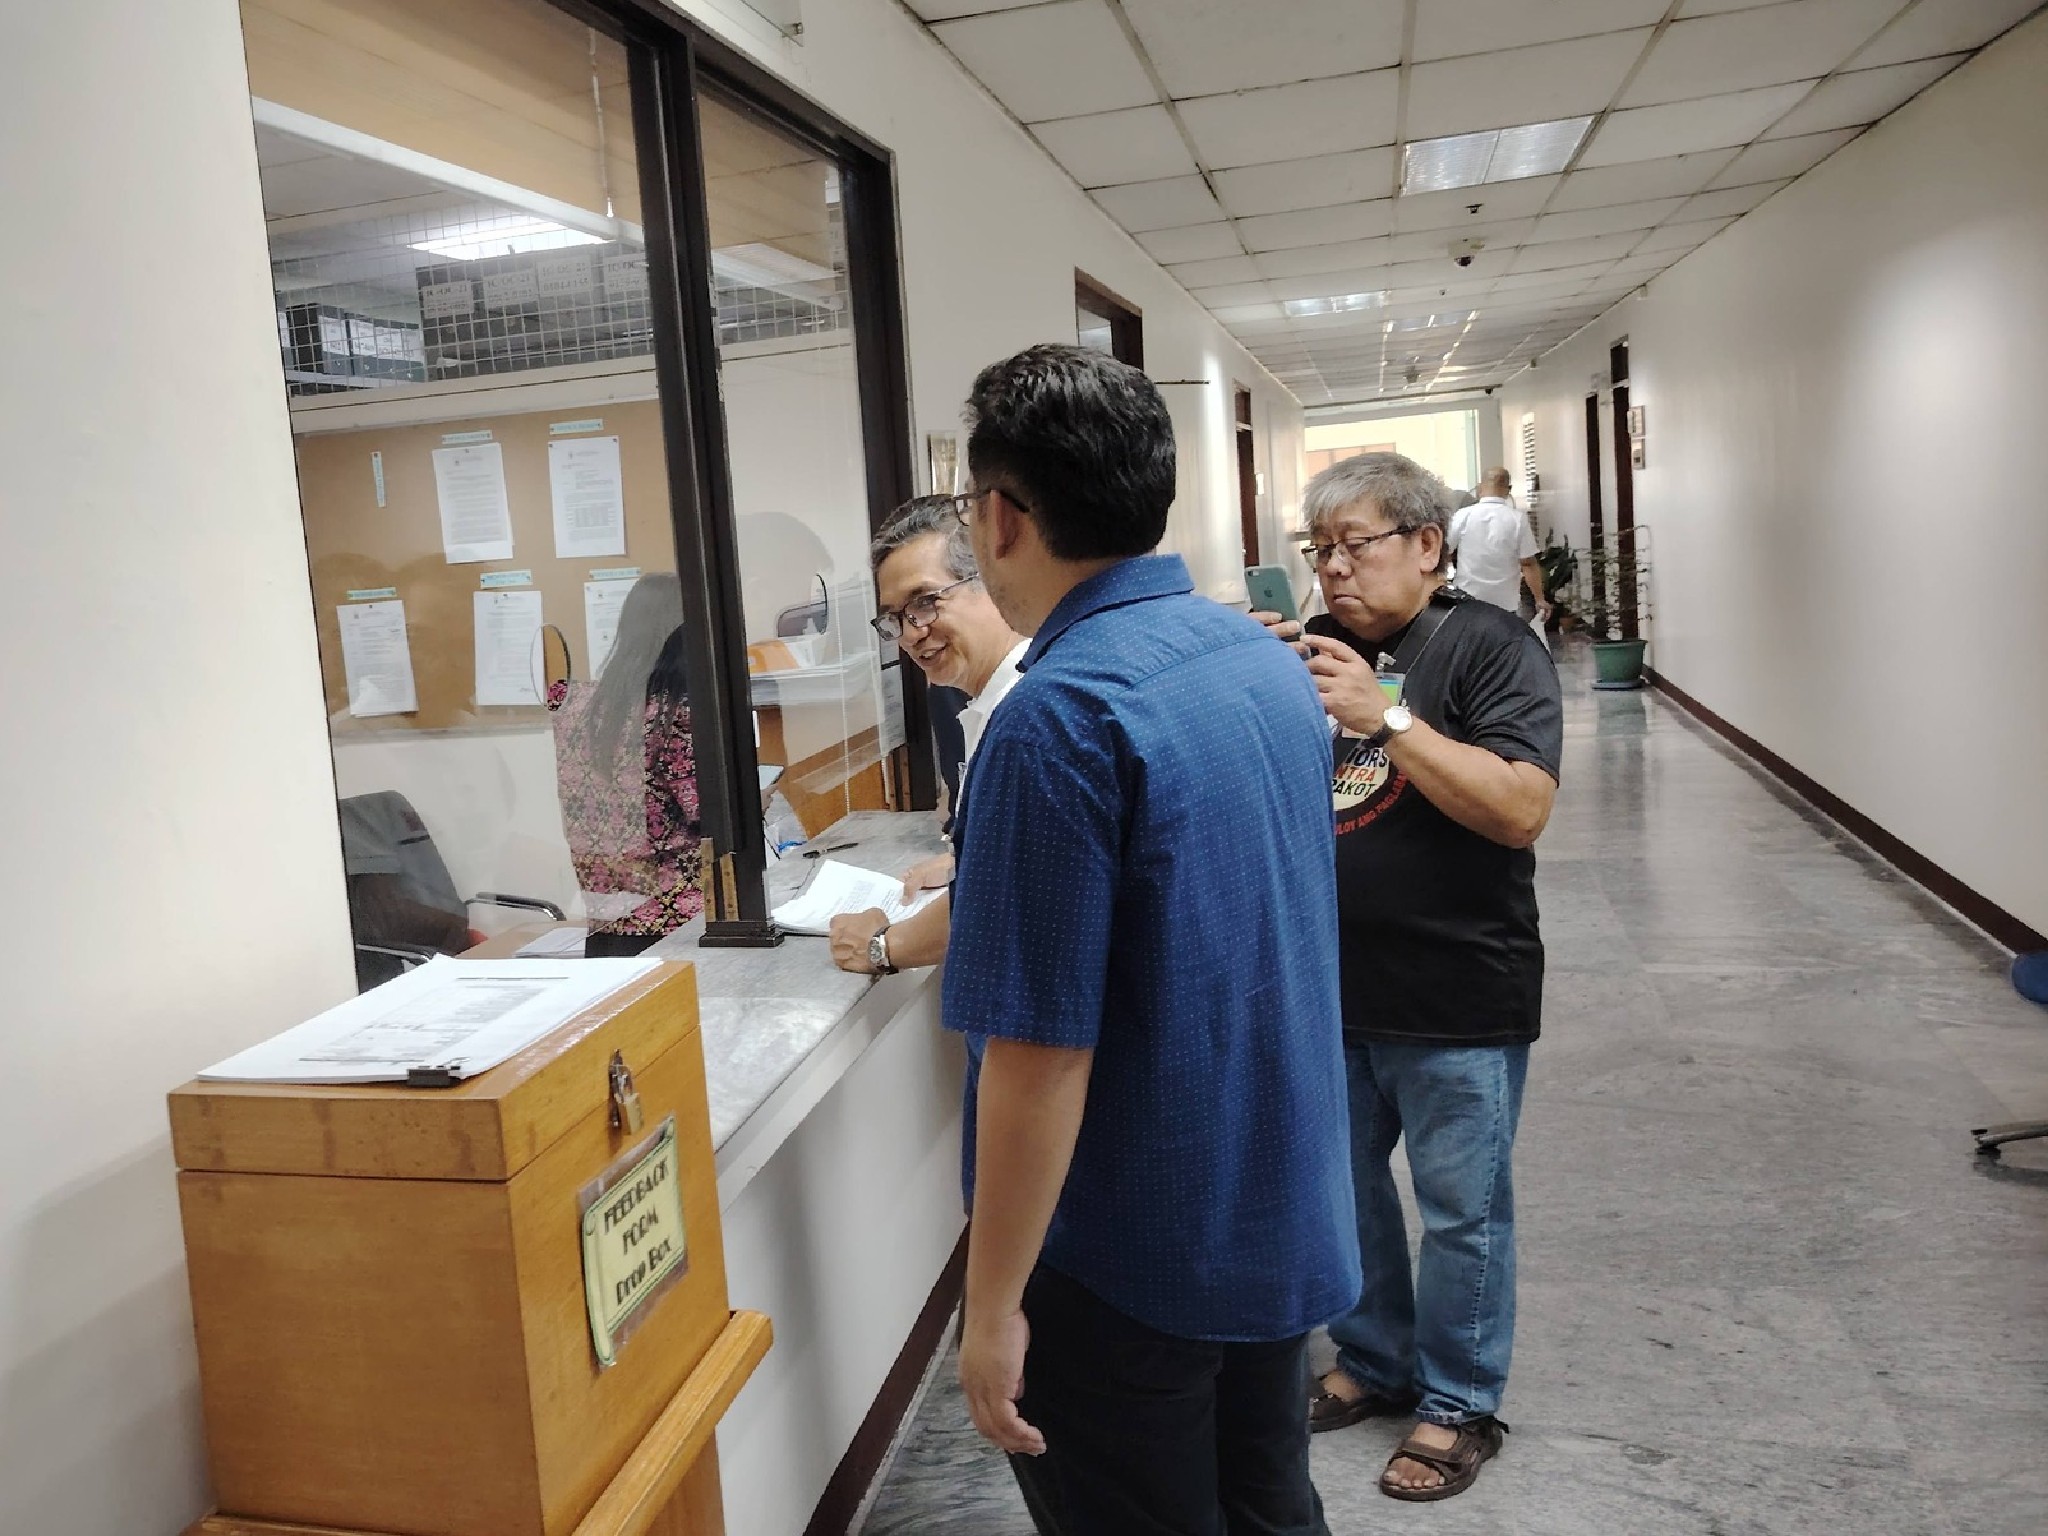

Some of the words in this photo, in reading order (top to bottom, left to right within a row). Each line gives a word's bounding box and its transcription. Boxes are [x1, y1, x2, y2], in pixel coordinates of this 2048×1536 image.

[604, 1156, 669, 1234] FEEDBACK
[623, 1204, 659, 1255] FORM
[648, 1236, 671, 1271] Box
